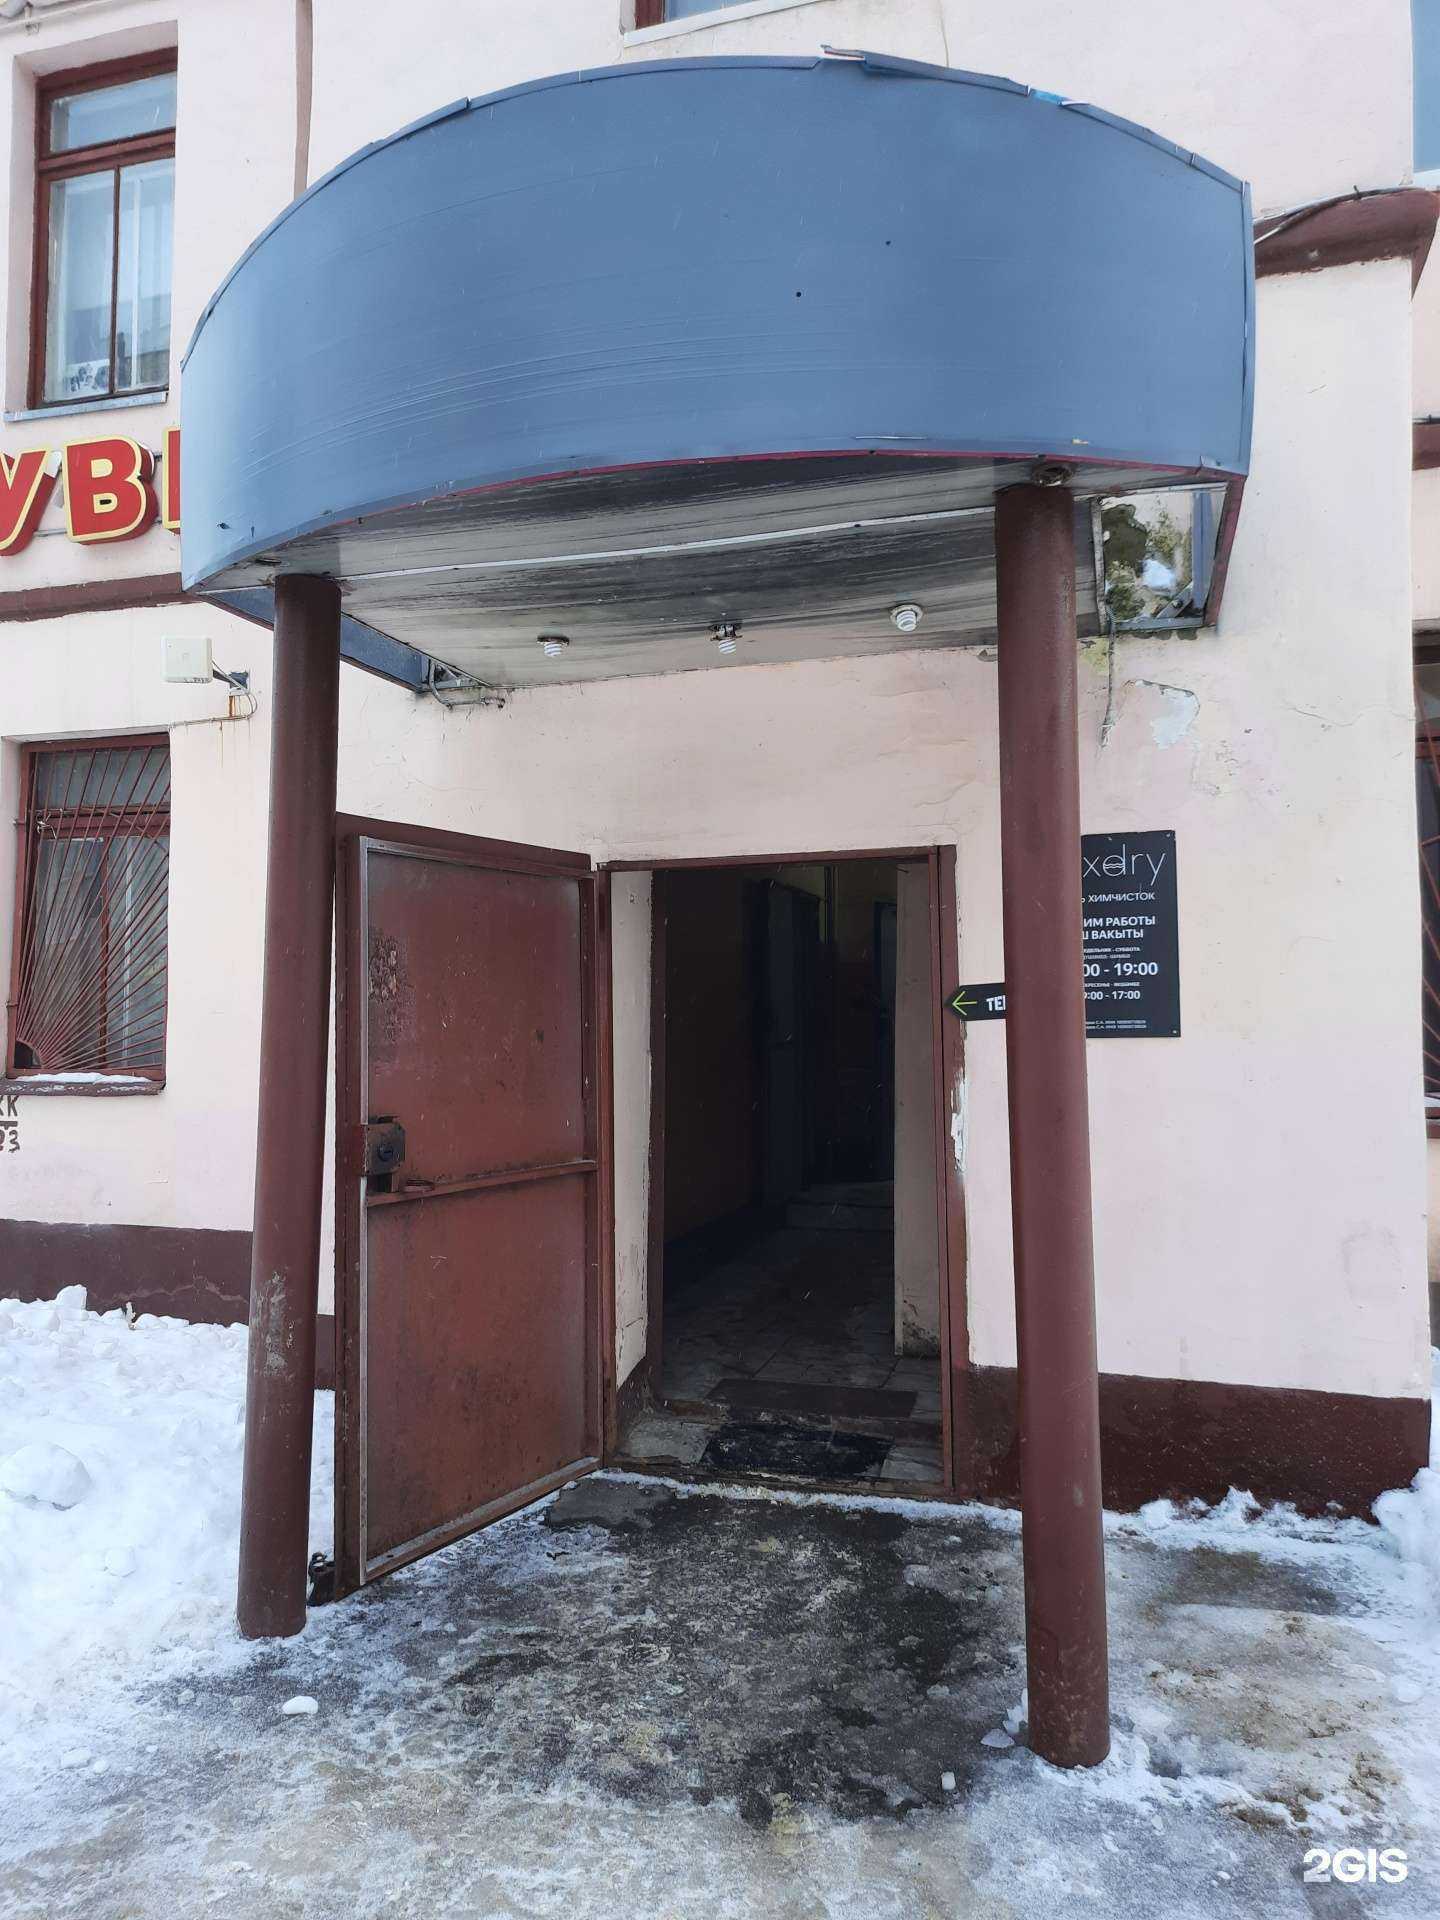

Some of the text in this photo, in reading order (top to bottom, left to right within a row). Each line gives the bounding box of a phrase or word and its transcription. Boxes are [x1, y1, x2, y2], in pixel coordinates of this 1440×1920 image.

[0, 426, 180, 556] УВ
[1088, 892, 1155, 903] ХИМЧИСТОК
[1105, 915, 1156, 926] РАБОТЫ
[1091, 928, 1144, 939] ВАКЫТЫ
[1113, 961, 1159, 976] 19:00
[1111, 990, 1141, 1000] 17:00
